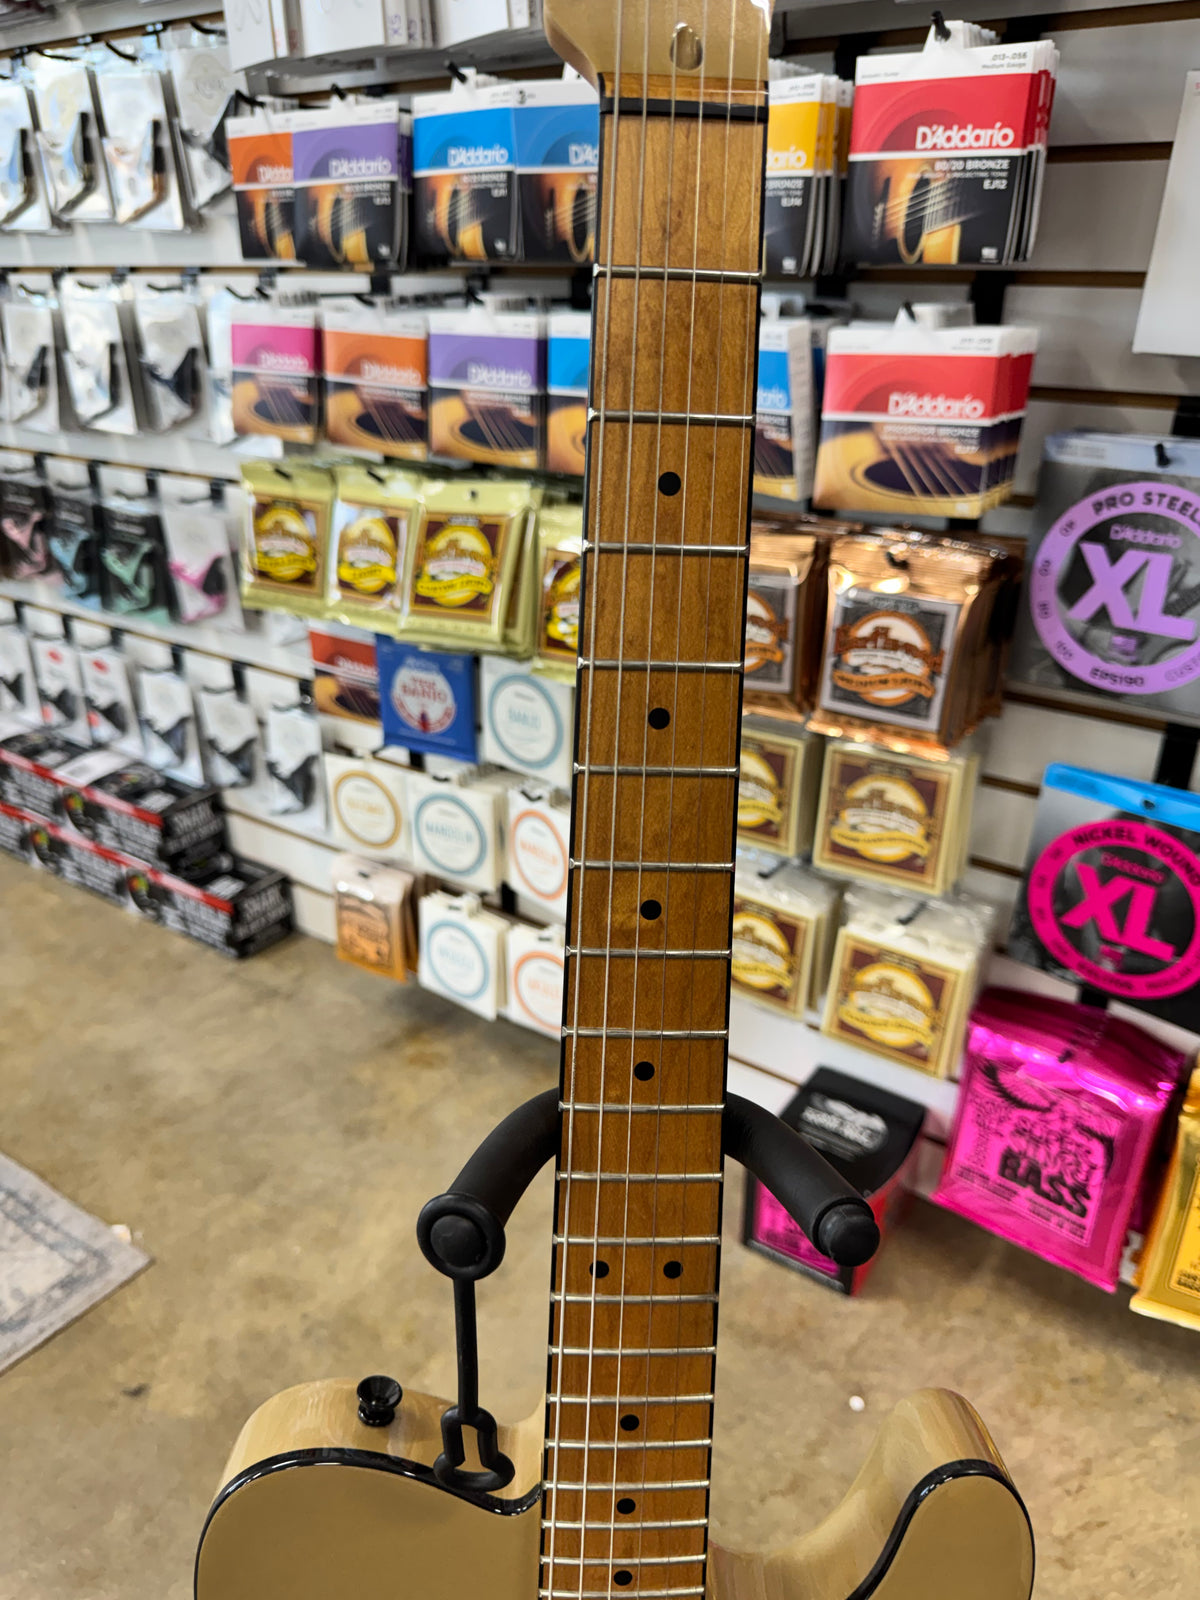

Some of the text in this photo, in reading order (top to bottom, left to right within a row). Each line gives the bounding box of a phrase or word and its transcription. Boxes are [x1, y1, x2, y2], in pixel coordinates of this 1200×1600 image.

[914, 121, 1015, 150] D'Addario
[328, 155, 392, 177] D'Addario
[447, 145, 508, 167] D'Addario
[965, 159, 1010, 170] BRONZE
[467, 363, 532, 389] D'Addario
[888, 391, 984, 418] D'Addario
[1092, 491, 1200, 527] PRO STEEL
[1067, 541, 1196, 642] XL
[1072, 826, 1137, 847] NICKEL
[1059, 860, 1176, 963] XL
[998, 1146, 1091, 1218] BASS
